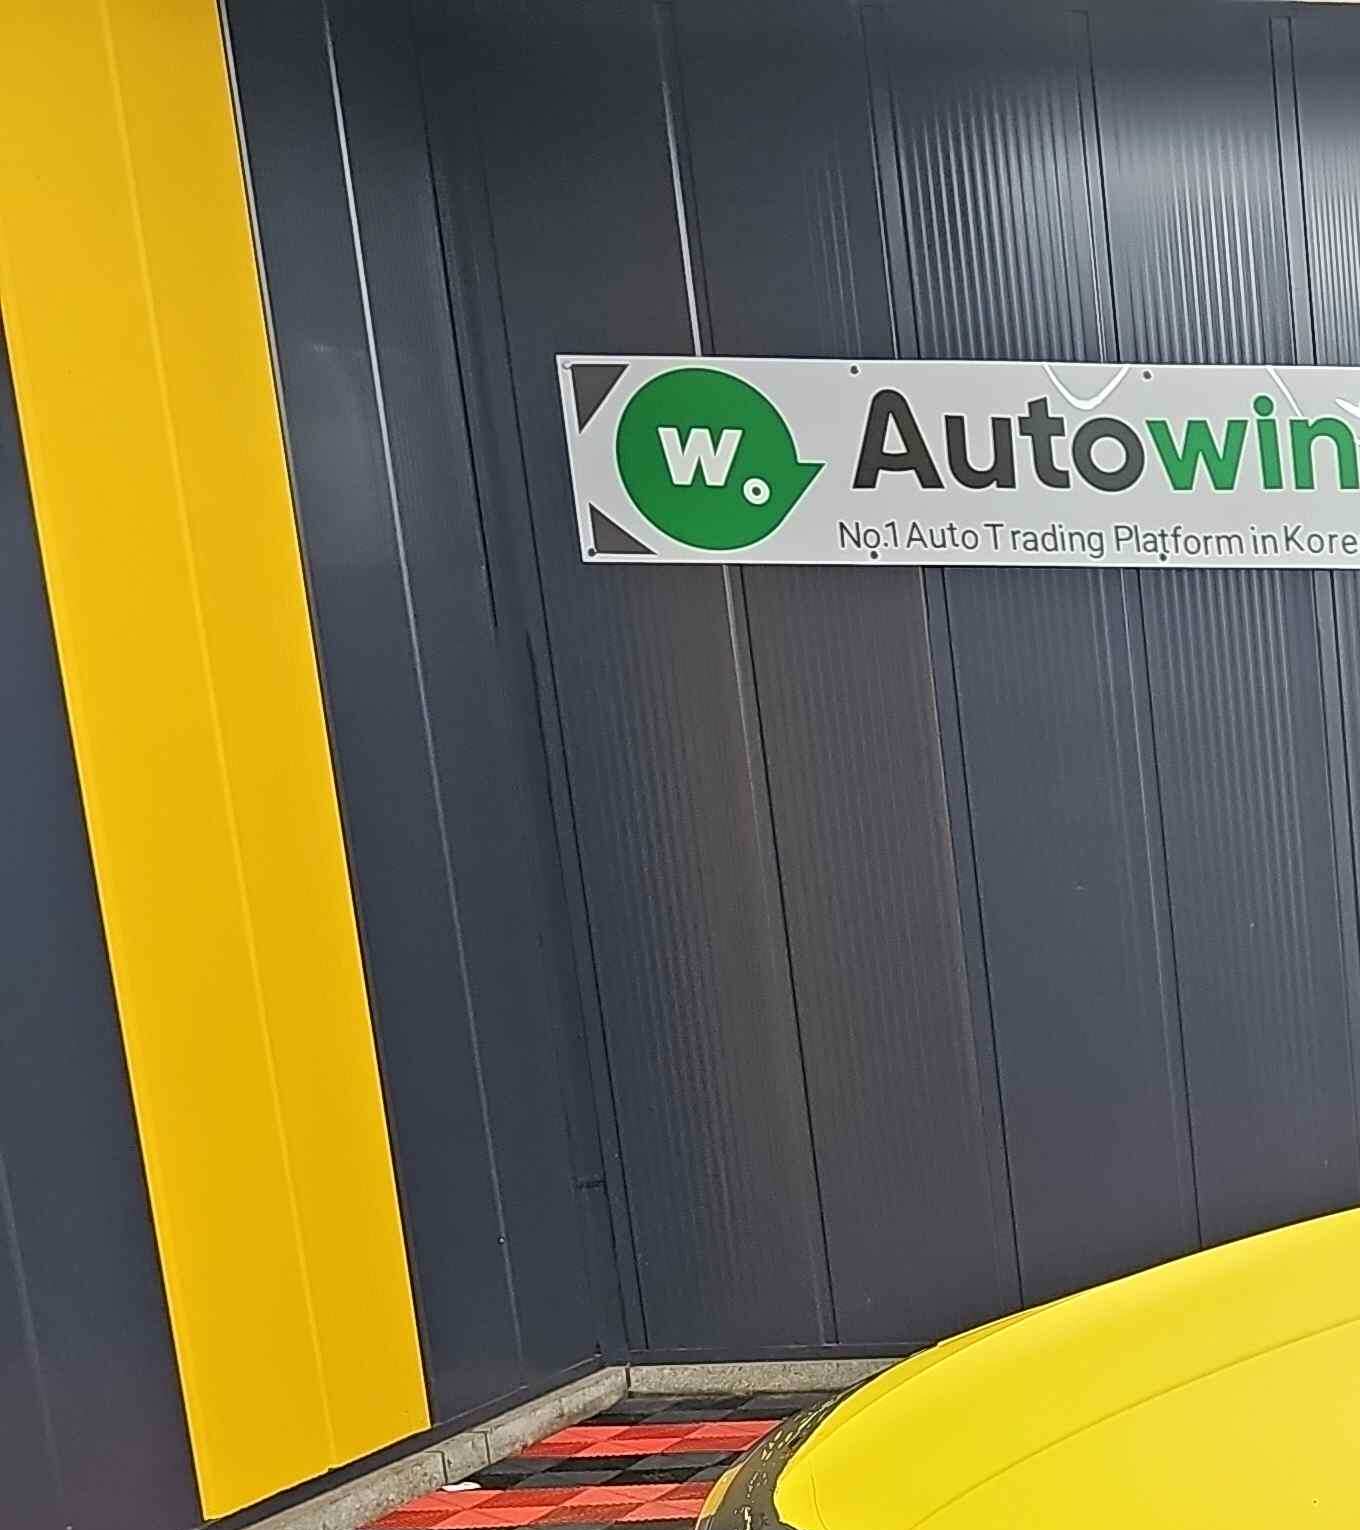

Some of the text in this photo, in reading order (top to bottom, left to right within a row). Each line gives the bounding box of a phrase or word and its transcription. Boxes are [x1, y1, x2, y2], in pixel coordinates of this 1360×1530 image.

[838, 519, 899, 553] No.1
[905, 520, 980, 552] Auto
[983, 522, 1105, 558] Trading
[1114, 525, 1246, 557] Platform
[1251, 525, 1279, 554] in
